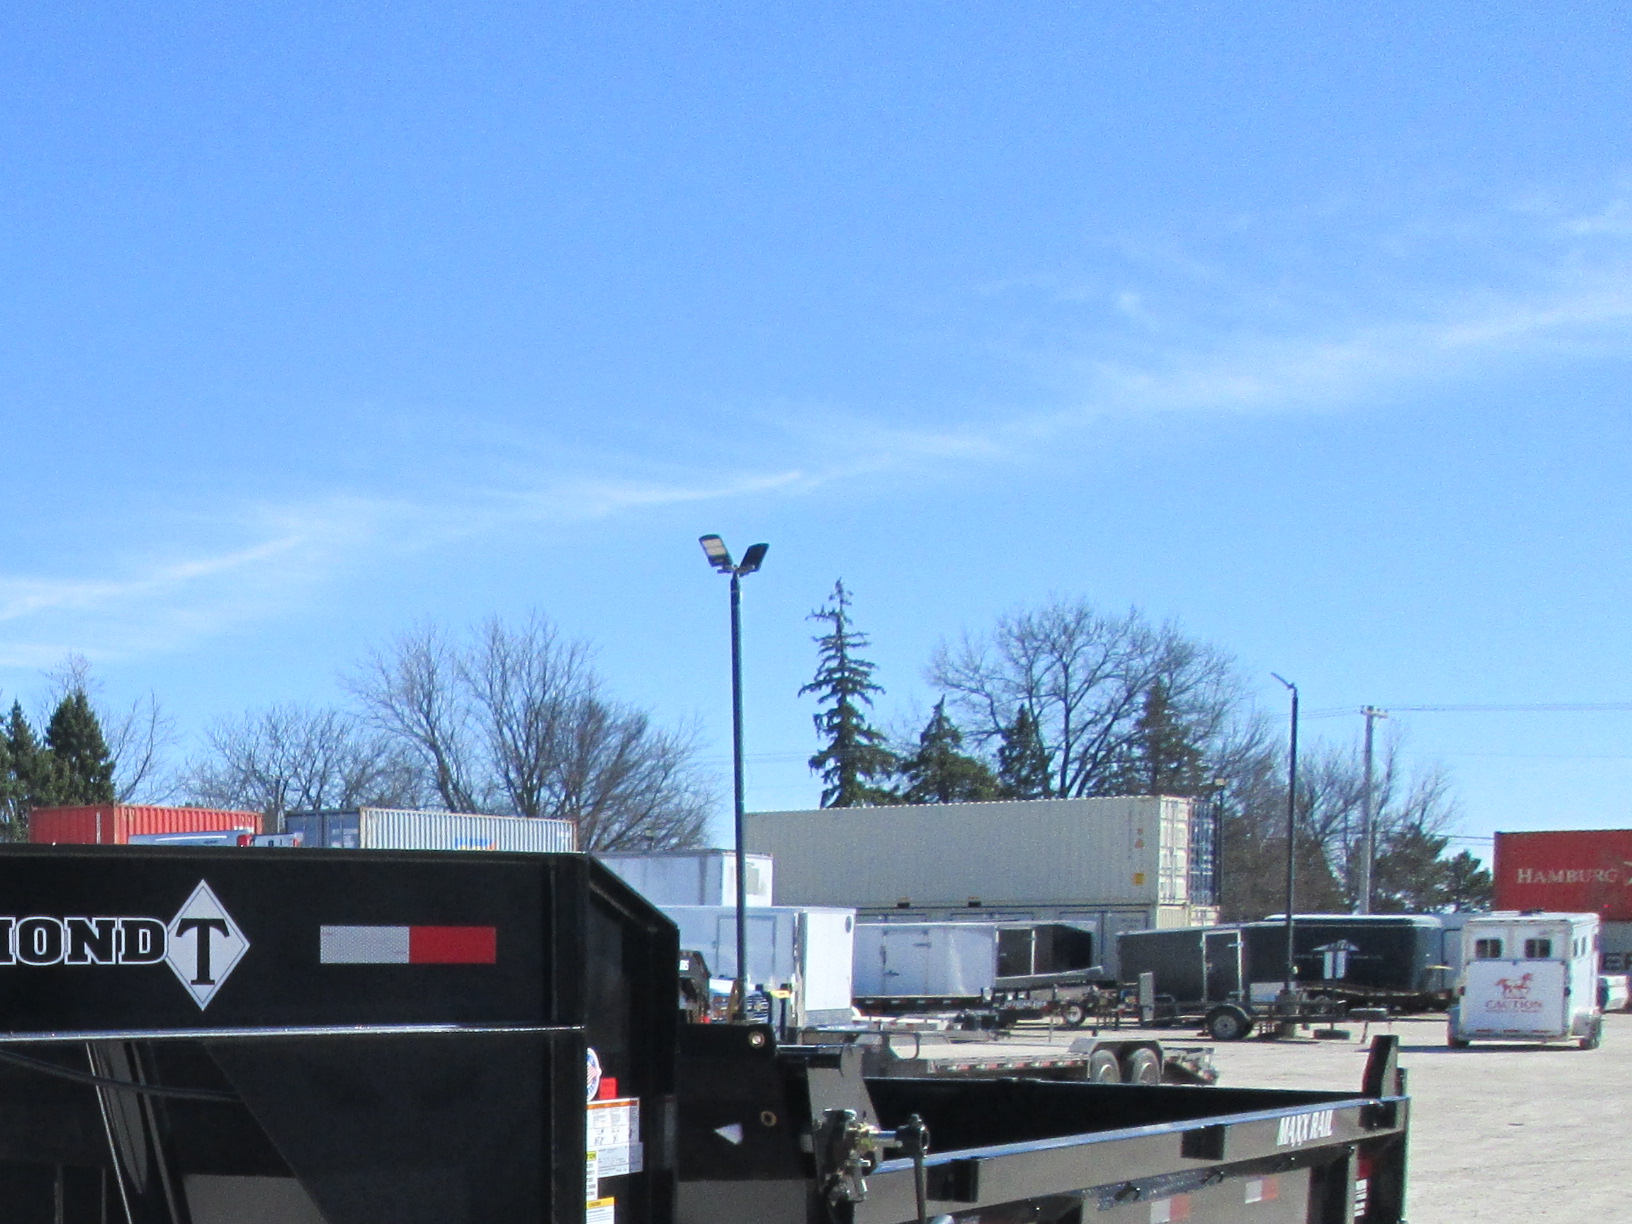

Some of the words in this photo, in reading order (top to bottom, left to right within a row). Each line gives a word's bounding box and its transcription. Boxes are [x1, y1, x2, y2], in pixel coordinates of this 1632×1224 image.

[1516, 868, 1618, 885] HAMBURG
[175, 918, 230, 986] T
[1309, 1110, 1333, 1139] RAIL
